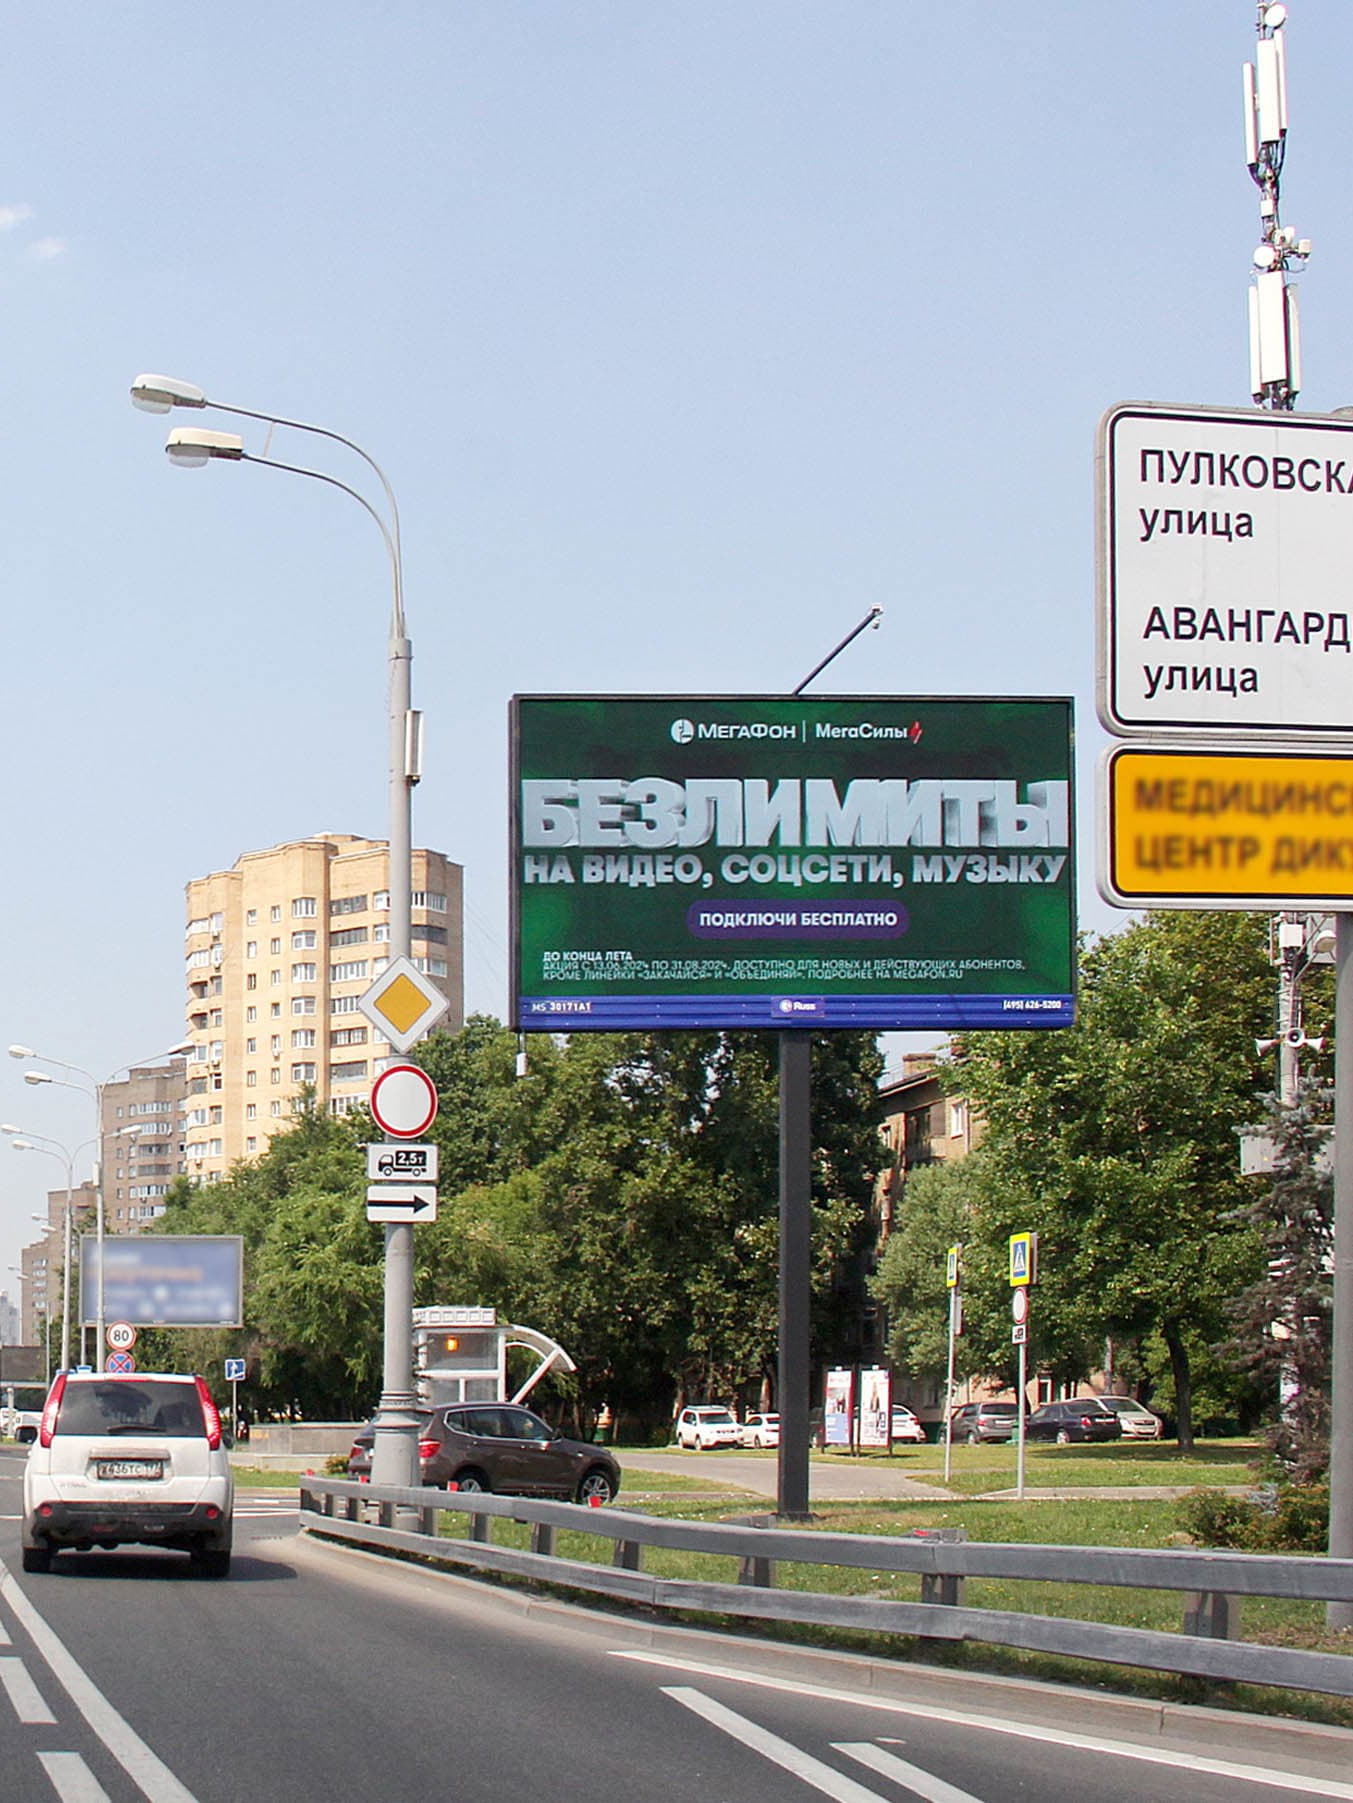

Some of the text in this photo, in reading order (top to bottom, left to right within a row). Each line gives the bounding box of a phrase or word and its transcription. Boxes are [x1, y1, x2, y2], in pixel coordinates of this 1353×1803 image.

[1140, 449, 1353, 494] ПУЛКОВСК
[1139, 508, 1254, 542] улица
[1143, 606, 1352, 653] АВАНГАРД
[1144, 665, 1259, 699] улица
[815, 723, 908, 739] МегаСилы
[521, 778, 1070, 847] БЕЗЛИМИТЫ
[1133, 779, 1353, 818] МЕДИЦИНС
[524, 853, 1067, 888] НА ВИДЕО, СОЦСЕТИ, МУЗЫКУ
[700, 912, 898, 928] ПОДКЛЮЧИ БЕСПЛАТНО
[543, 951, 633, 962] ДО КОНЦА ЛЕТА
[543, 960, 579, 971] АКЦИЯ
[581, 960, 591, 970] С
[651, 960, 669, 970] ПО
[733, 960, 795, 970] ДОСТУПНО
[797, 960, 819, 970] ДЛЯ
[821, 960, 860, 969] НОВЫХ
[863, 960, 872, 969] И
[874, 958, 957, 970] ДЕЙСТВУЮЩИХ
[543, 970, 581, 980] КРОМЕ
[583, 969, 636, 980] ЛИНЕЙКИ
[714, 970, 723, 979] И
[808, 969, 873, 979] ПОДРОБНЕЕ
[875, 969, 891, 979] НА
[113, 1329, 129, 1342] 80
